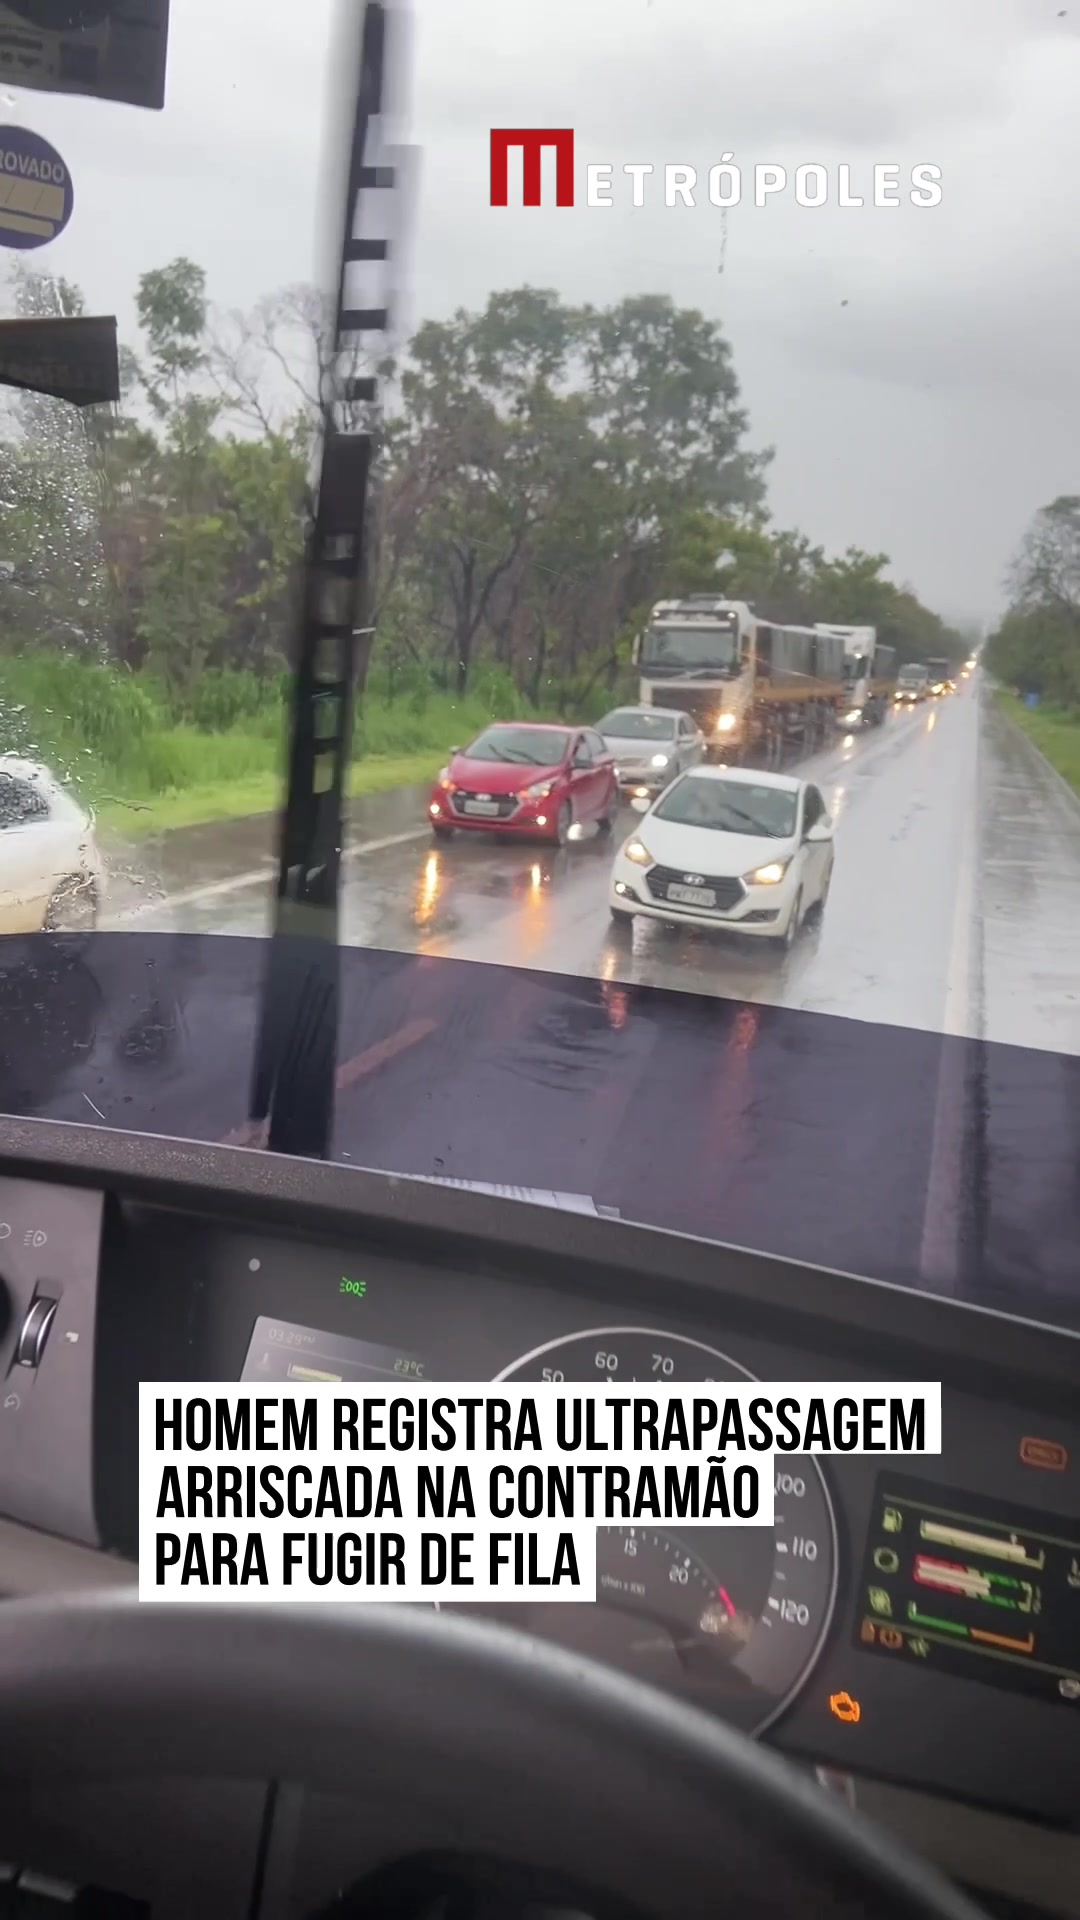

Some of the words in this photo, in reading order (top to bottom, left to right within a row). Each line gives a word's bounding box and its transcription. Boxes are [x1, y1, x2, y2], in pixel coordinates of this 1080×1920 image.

[594, 1351, 618, 1372] 60
[651, 1353, 675, 1375] 70
[541, 1367, 565, 1382] 50
[776, 1471, 806, 1497] 100
[624, 1538, 638, 1557] 15
[792, 1536, 817, 1562] 110
[669, 1564, 689, 1584] 20
[780, 1598, 809, 1626] 120
